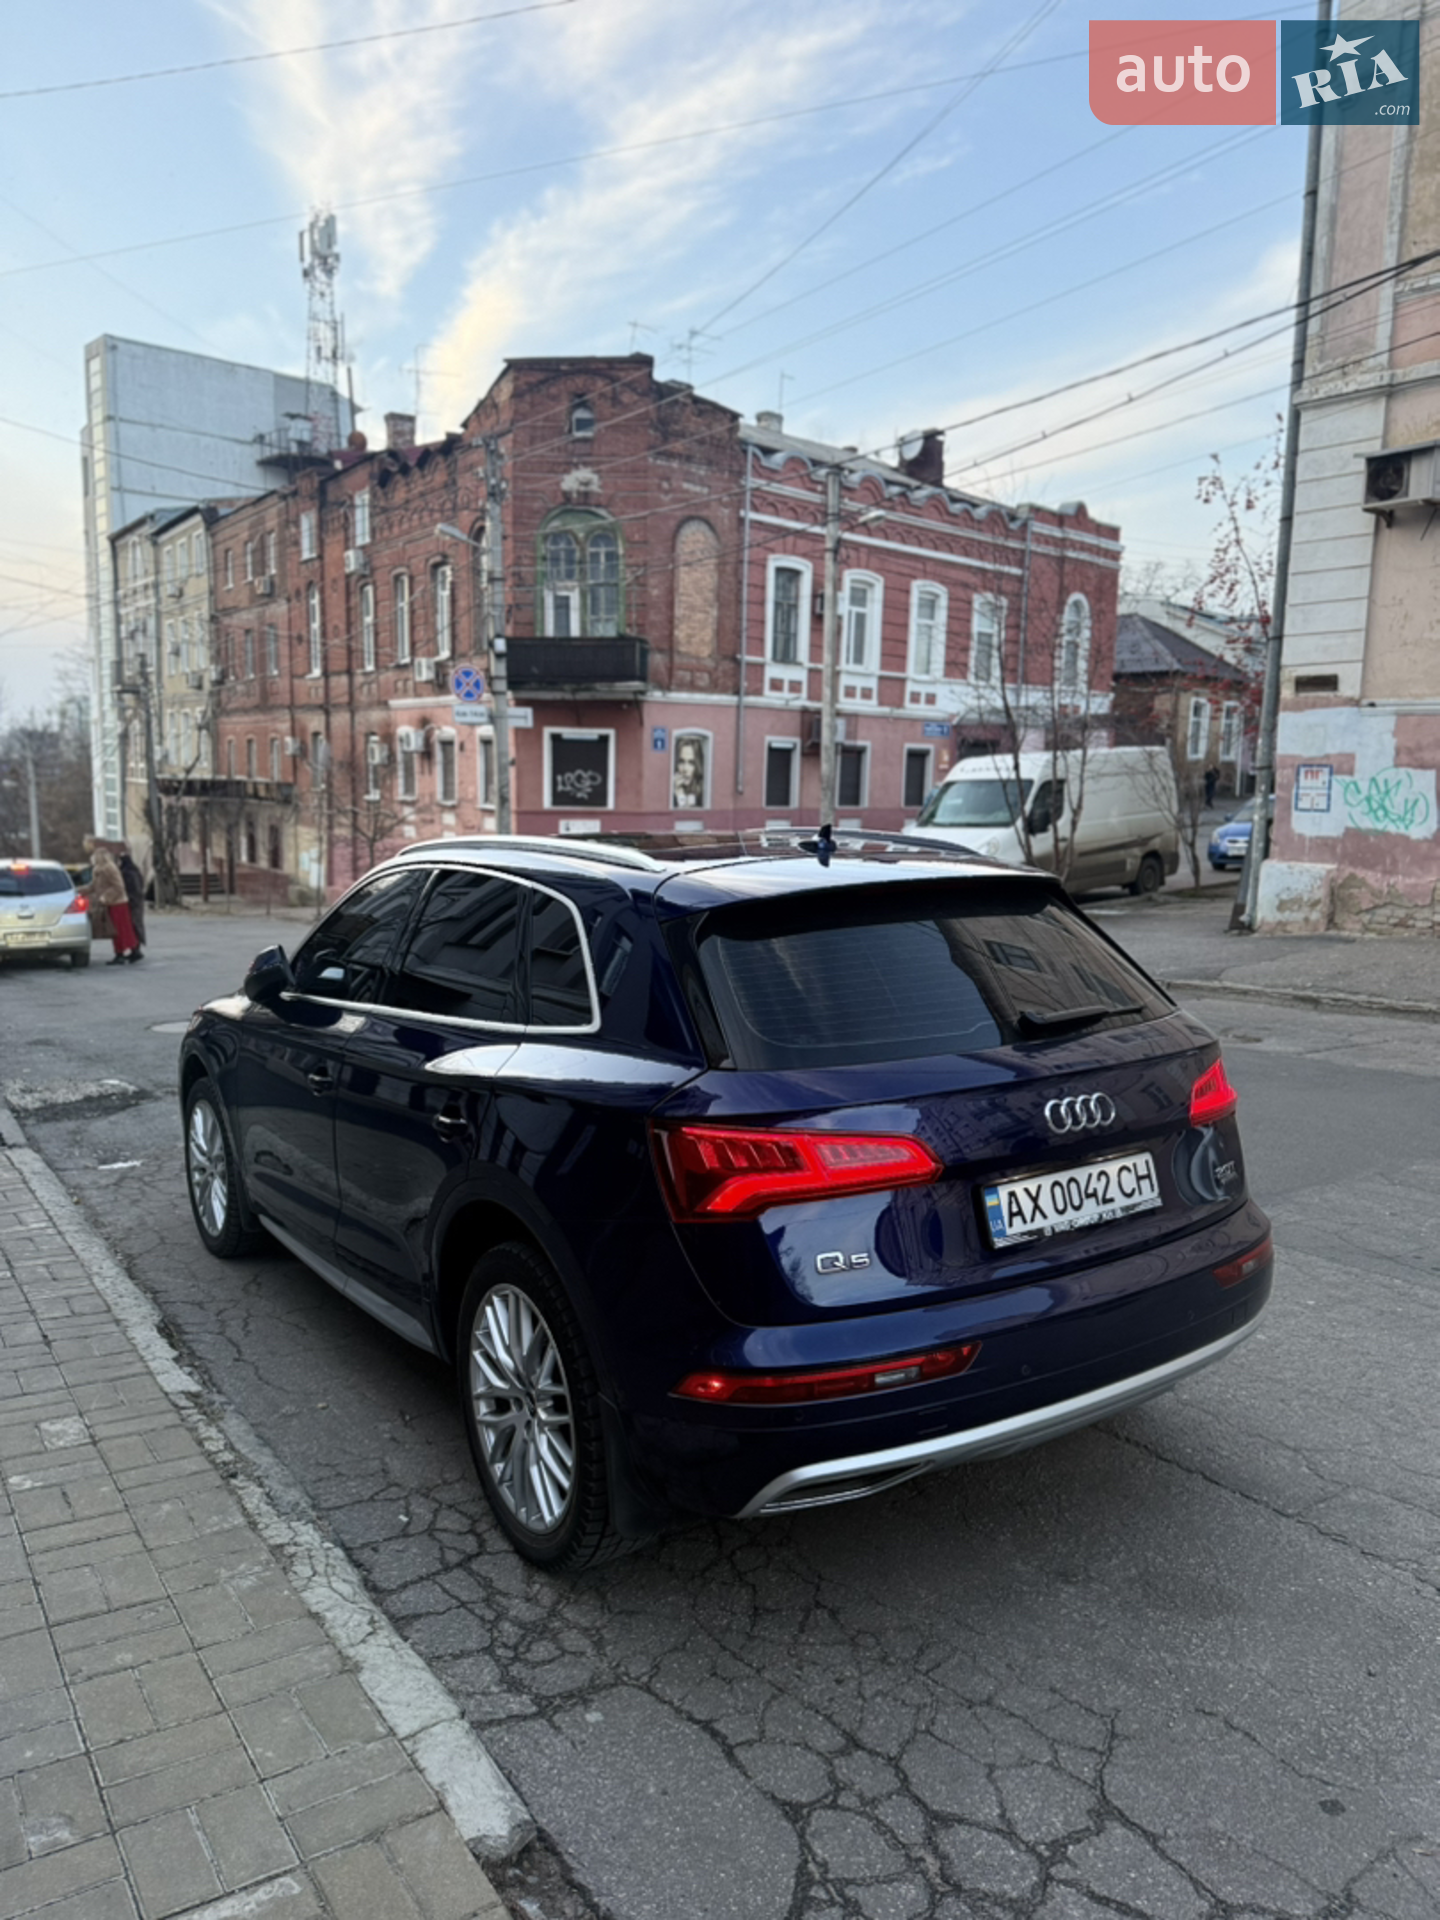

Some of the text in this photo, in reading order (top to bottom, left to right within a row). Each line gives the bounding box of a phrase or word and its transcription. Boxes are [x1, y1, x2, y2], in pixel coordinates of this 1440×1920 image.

[1007, 1184, 1048, 1229] AX
[1050, 1169, 1115, 1216] 0042
[1117, 1158, 1155, 1199] CH
[816, 1251, 870, 1274] Q5
